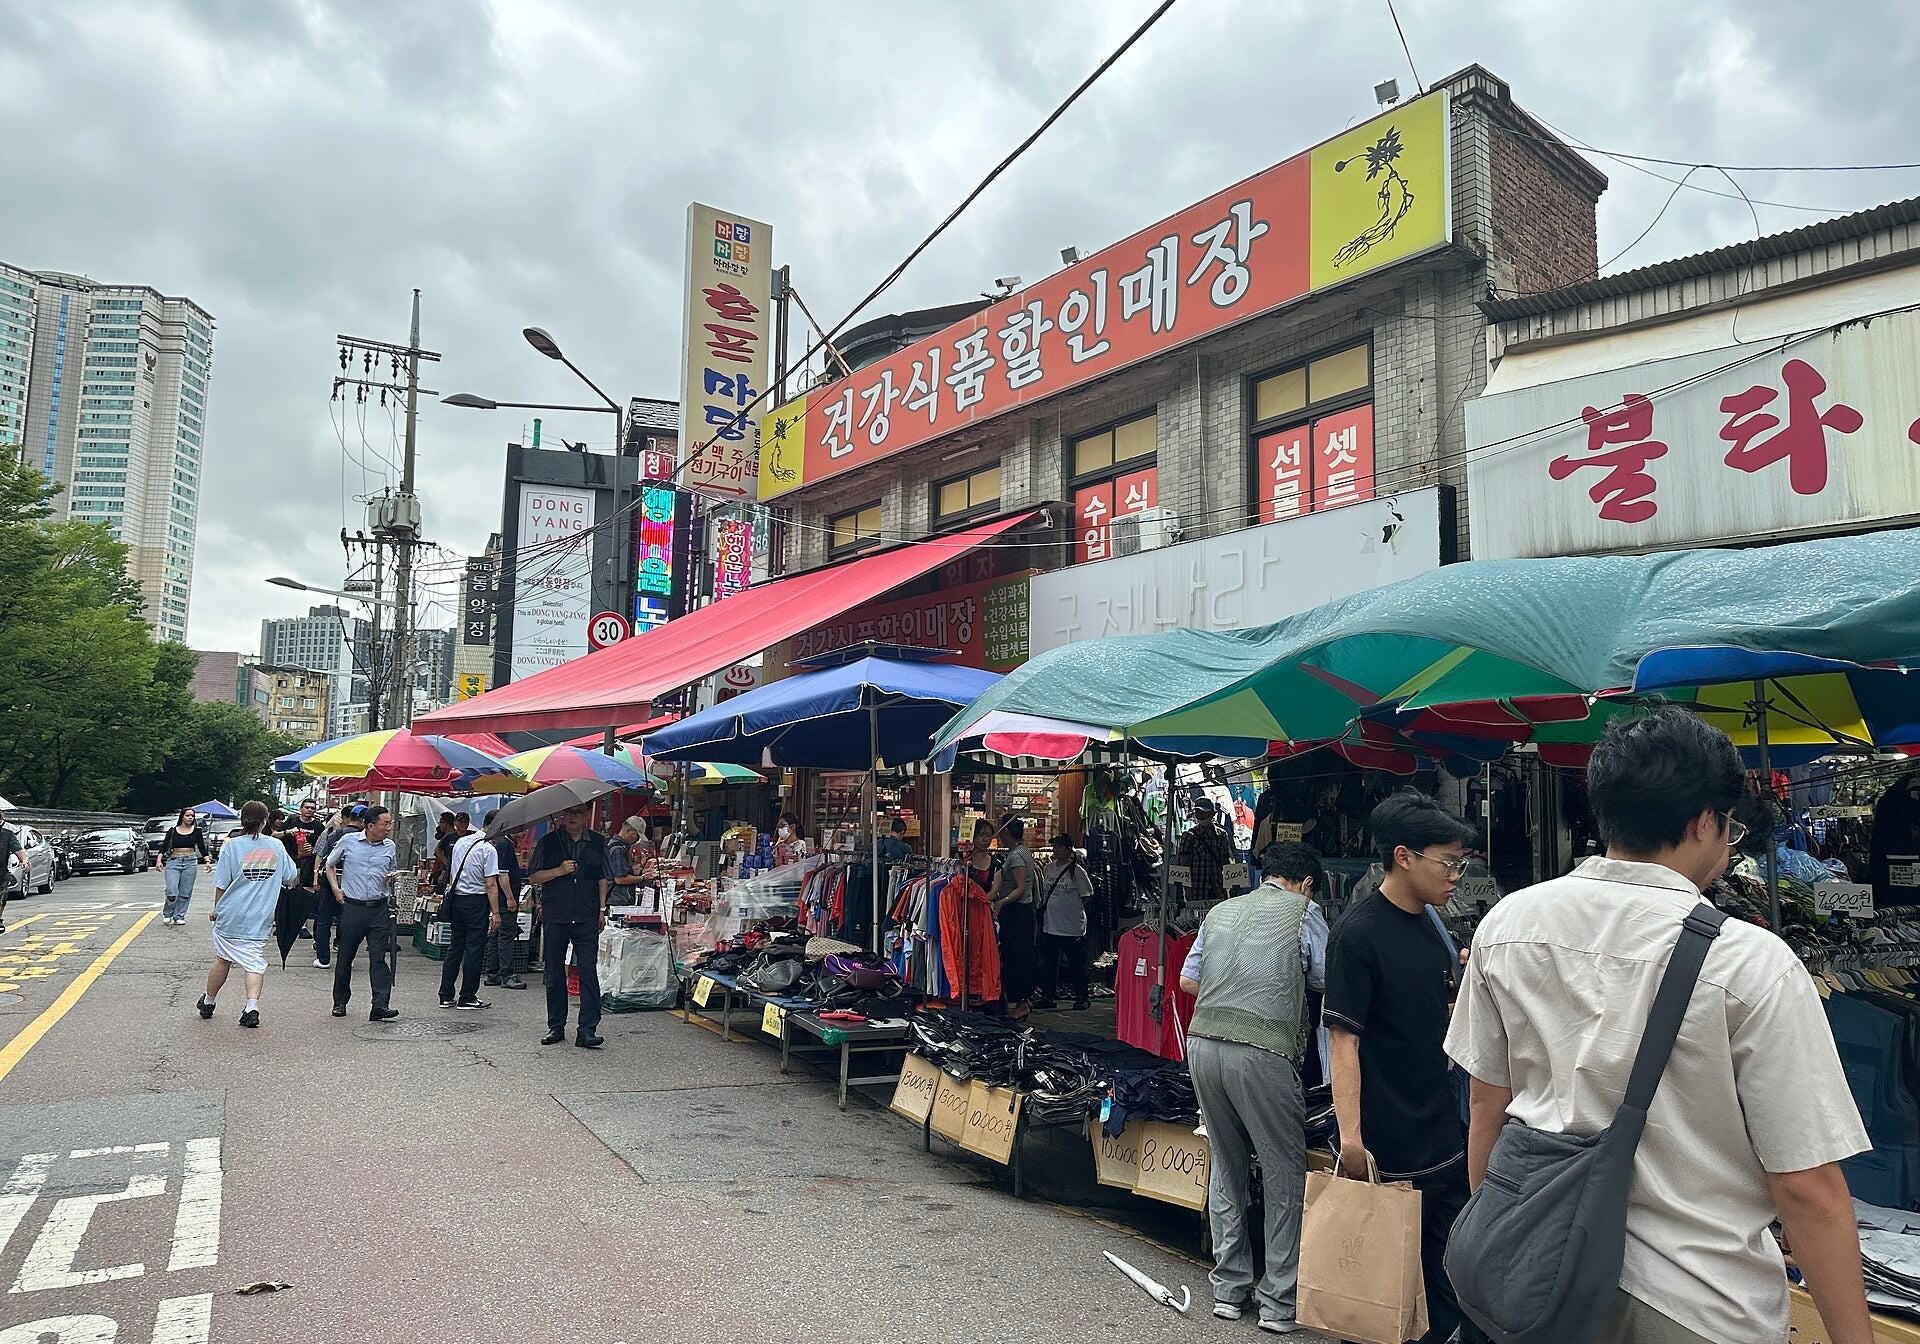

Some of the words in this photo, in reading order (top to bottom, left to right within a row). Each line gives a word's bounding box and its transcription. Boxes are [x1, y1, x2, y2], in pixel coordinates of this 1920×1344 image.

[702, 282, 760, 363] 호프
[820, 199, 1269, 460] 건강식품할인매장
[703, 367, 757, 440] 마당
[1549, 359, 1920, 523] 불타
[1323, 425, 1359, 507] 셋트
[1270, 438, 1301, 519] 선물
[532, 498, 583, 514] DONG
[531, 515, 582, 530] YANG
[1083, 495, 1107, 560] 수입
[988, 582, 1028, 605] 수입과자
[469, 574, 488, 637] 동양장
[532, 609, 550, 617] DONG
[551, 610, 568, 619] YANG
[989, 602, 1028, 624] 건강식품
[598, 621, 619, 641] 30
[989, 621, 1028, 642] 수입식품
[517, 657, 536, 665] DONG
[537, 657, 553, 666] YANG
[990, 640, 1028, 661] 선물셋트
